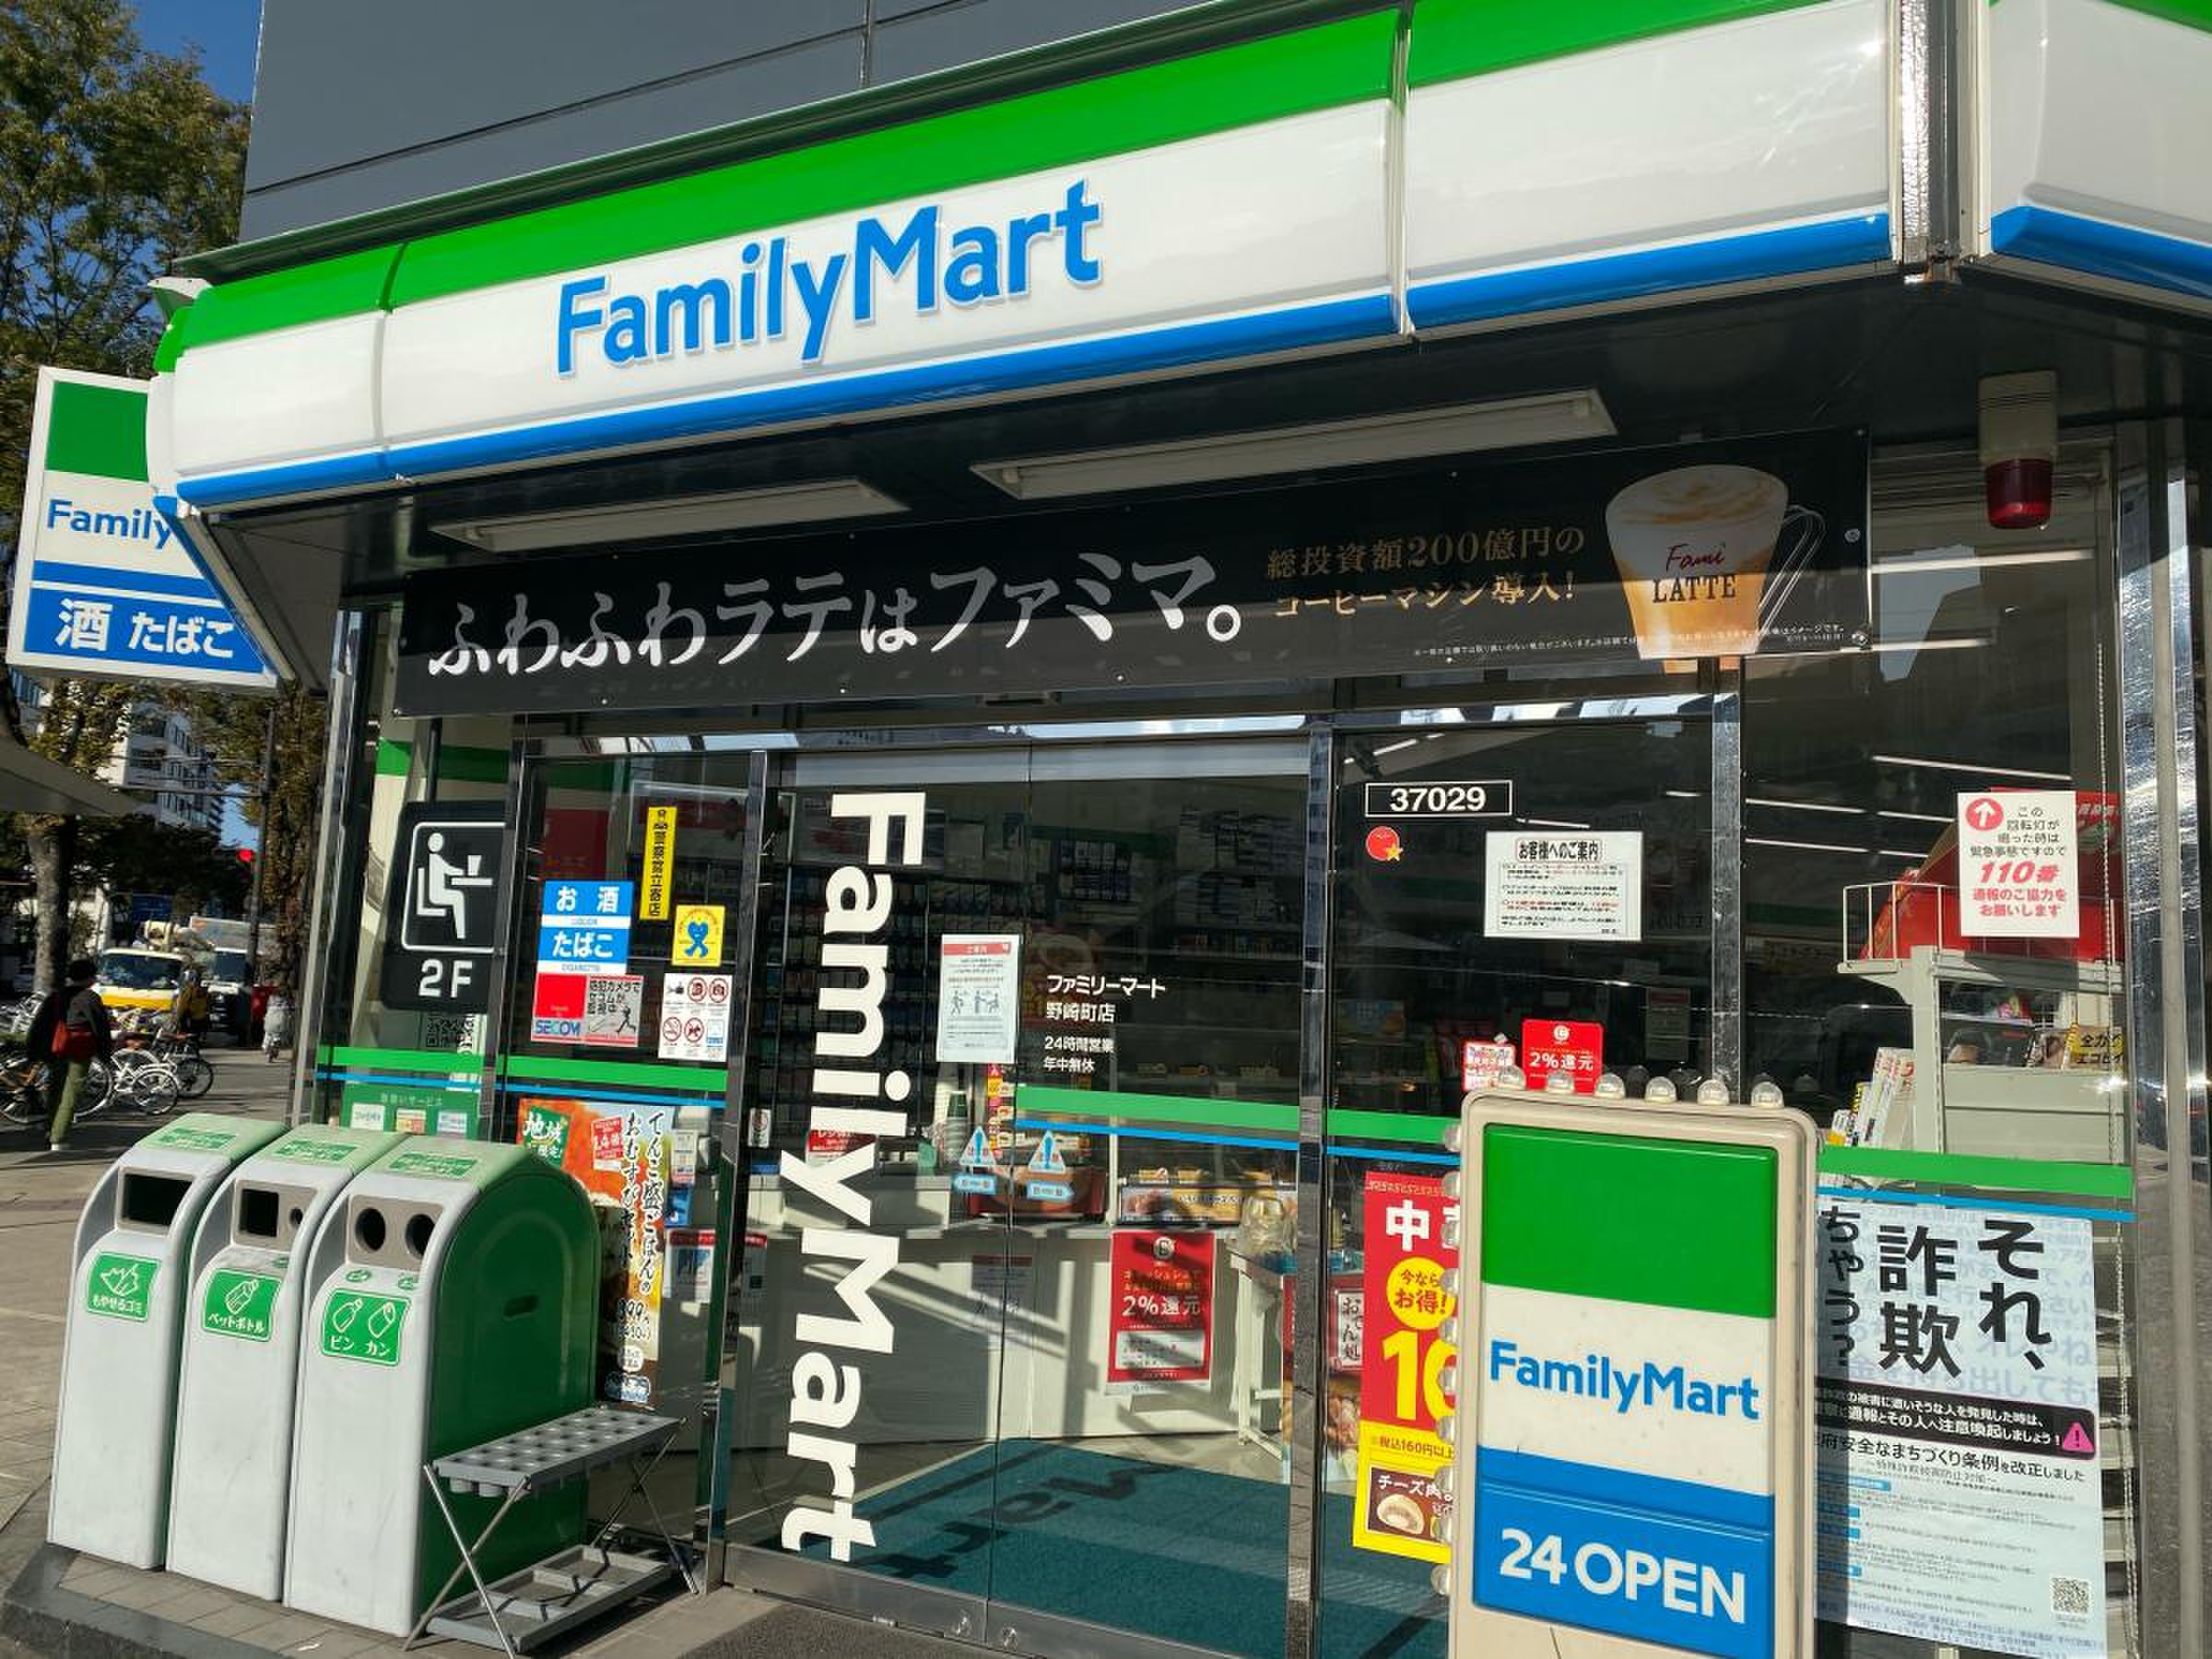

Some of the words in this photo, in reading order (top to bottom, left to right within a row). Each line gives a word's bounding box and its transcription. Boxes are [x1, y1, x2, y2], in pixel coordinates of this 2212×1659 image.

[557, 178, 1102, 376] FamilyMart
[1267, 525, 1585, 580] 総投資額200億円の
[1665, 542, 1726, 572] Fami
[1652, 573, 1736, 604] LATTE
[428, 553, 1242, 677] ふわふわラテはファミマ。
[54, 597, 113, 652] 酒
[128, 611, 234, 658] たばこ
[1389, 786, 1486, 812] 37029
[2018, 806, 2043, 818] この
[2006, 818, 2060, 831] 回転灯が
[1518, 840, 1599, 861] お客様へのご案内
[1979, 860, 2061, 884] 110番
[1971, 888, 2066, 901] 通報のご協力を
[1979, 903, 2061, 917] お願いします
[551, 930, 614, 959] たばこ
[418, 959, 473, 999] 2F
[1046, 972, 1167, 999] ファミリーマート
[1045, 1001, 1117, 1023] 野崎町店
[535, 1019, 582, 1036] SECOM
[1043, 1035, 1115, 1053] 24時間営業
[1042, 1055, 1096, 1073] 年中無休
[1528, 1052, 1594, 1072] 2%還元
[781, 791, 926, 1563] FamilyMart
[1400, 1268, 1441, 1288] 今なら
[91, 1292, 146, 1316] もやせるゴミ
[1121, 1295, 1201, 1317] 2%還元
[1394, 1288, 1448, 1316] お得!
[1877, 1225, 1961, 1378] 詐欺
[1977, 1218, 2052, 1371] それ、
[207, 1312, 265, 1335] ペットボトル
[329, 1335, 355, 1353] ビン
[366, 1341, 391, 1359] カン
[1489, 1339, 1759, 1420] FamilyMart
